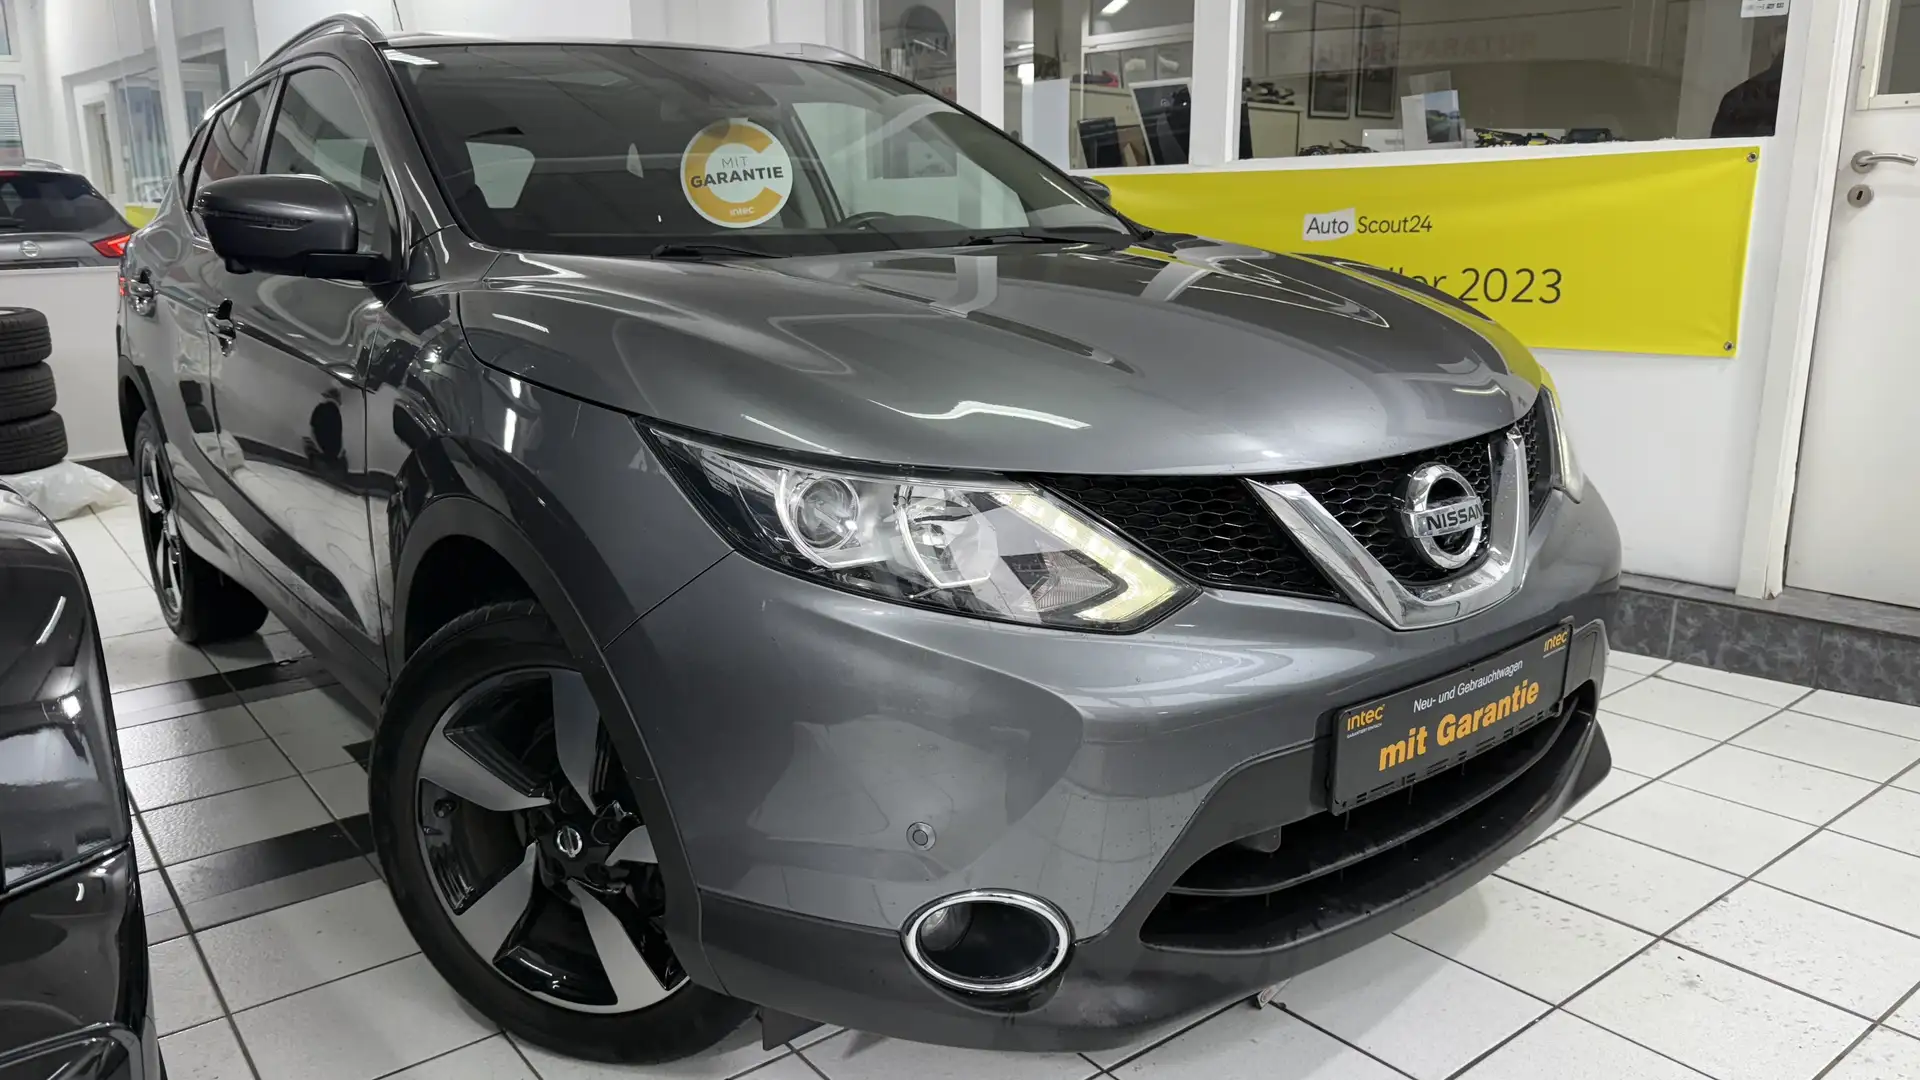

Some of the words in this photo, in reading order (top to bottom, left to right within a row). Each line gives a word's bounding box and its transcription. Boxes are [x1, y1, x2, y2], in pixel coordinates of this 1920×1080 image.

[721, 156, 748, 169] MIT
[690, 166, 784, 188] GARANTIE
[1306, 217, 1349, 235] Auto
[1357, 215, 1432, 234] Scout24
[1458, 267, 1562, 304] 2023
[1426, 503, 1484, 531] NISSAN
[1413, 698, 1436, 713] Neu-
[1438, 686, 1455, 704] und
[1457, 660, 1523, 696] Gebrauchtwagen
[1378, 725, 1428, 772] mit
[1436, 679, 1540, 746] Garantie
